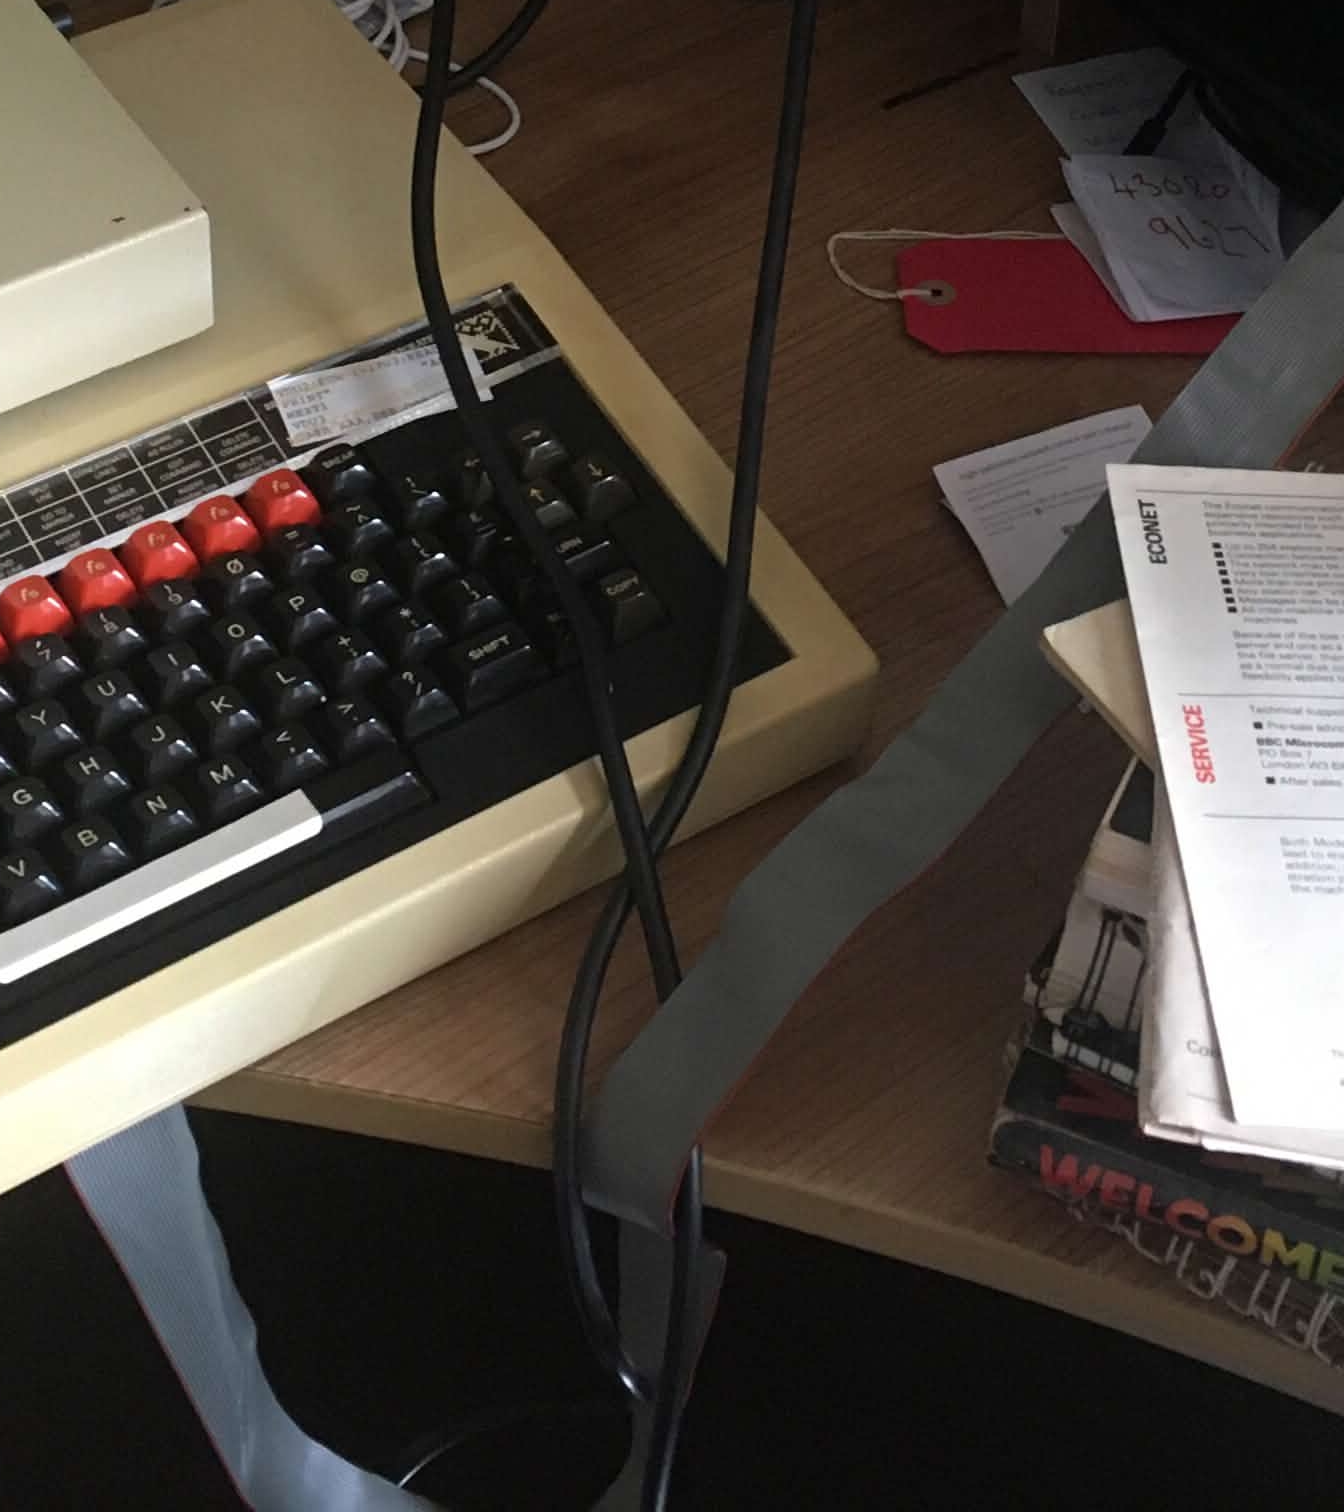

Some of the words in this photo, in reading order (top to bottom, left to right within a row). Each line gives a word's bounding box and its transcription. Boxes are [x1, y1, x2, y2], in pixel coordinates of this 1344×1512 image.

[1138, 499, 1168, 565] ECONET
[288, 595, 305, 612] P
[227, 623, 245, 638] O
[276, 671, 297, 685] L
[98, 681, 116, 696] U
[210, 696, 233, 714] K
[31, 710, 48, 726] Y
[152, 726, 166, 743] J
[1183, 704, 1217, 785] SERVICE
[79, 756, 101, 776] H
[210, 764, 236, 785] M
[12, 789, 33, 805] G
[146, 796, 168, 815] N
[77, 829, 99, 848] B
[7, 860, 26, 877] V
